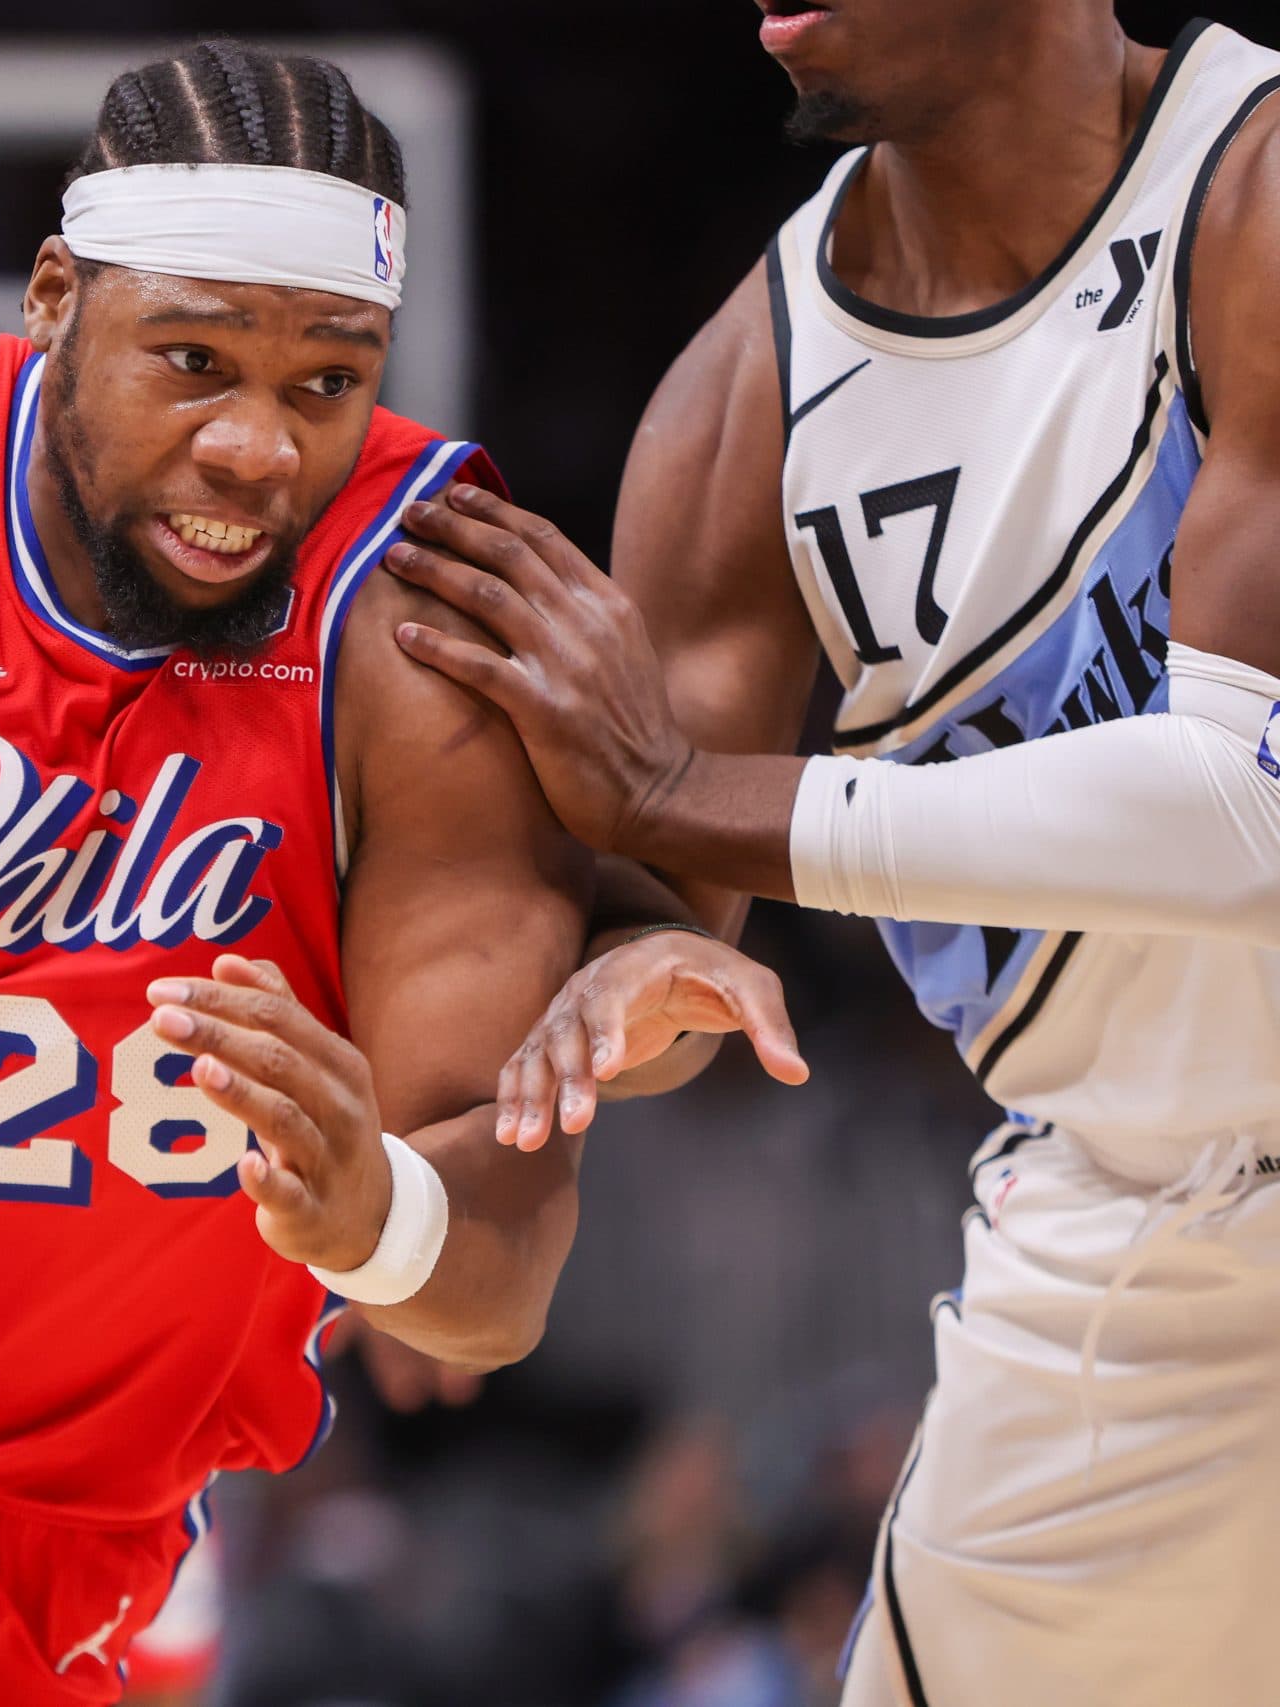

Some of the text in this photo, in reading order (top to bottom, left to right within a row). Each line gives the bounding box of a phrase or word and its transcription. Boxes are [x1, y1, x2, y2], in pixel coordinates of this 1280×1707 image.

[1075, 288, 1103, 309] the
[1125, 299, 1144, 324] YMCA
[794, 466, 962, 667] 17
[174, 660, 314, 684] crypto.com
